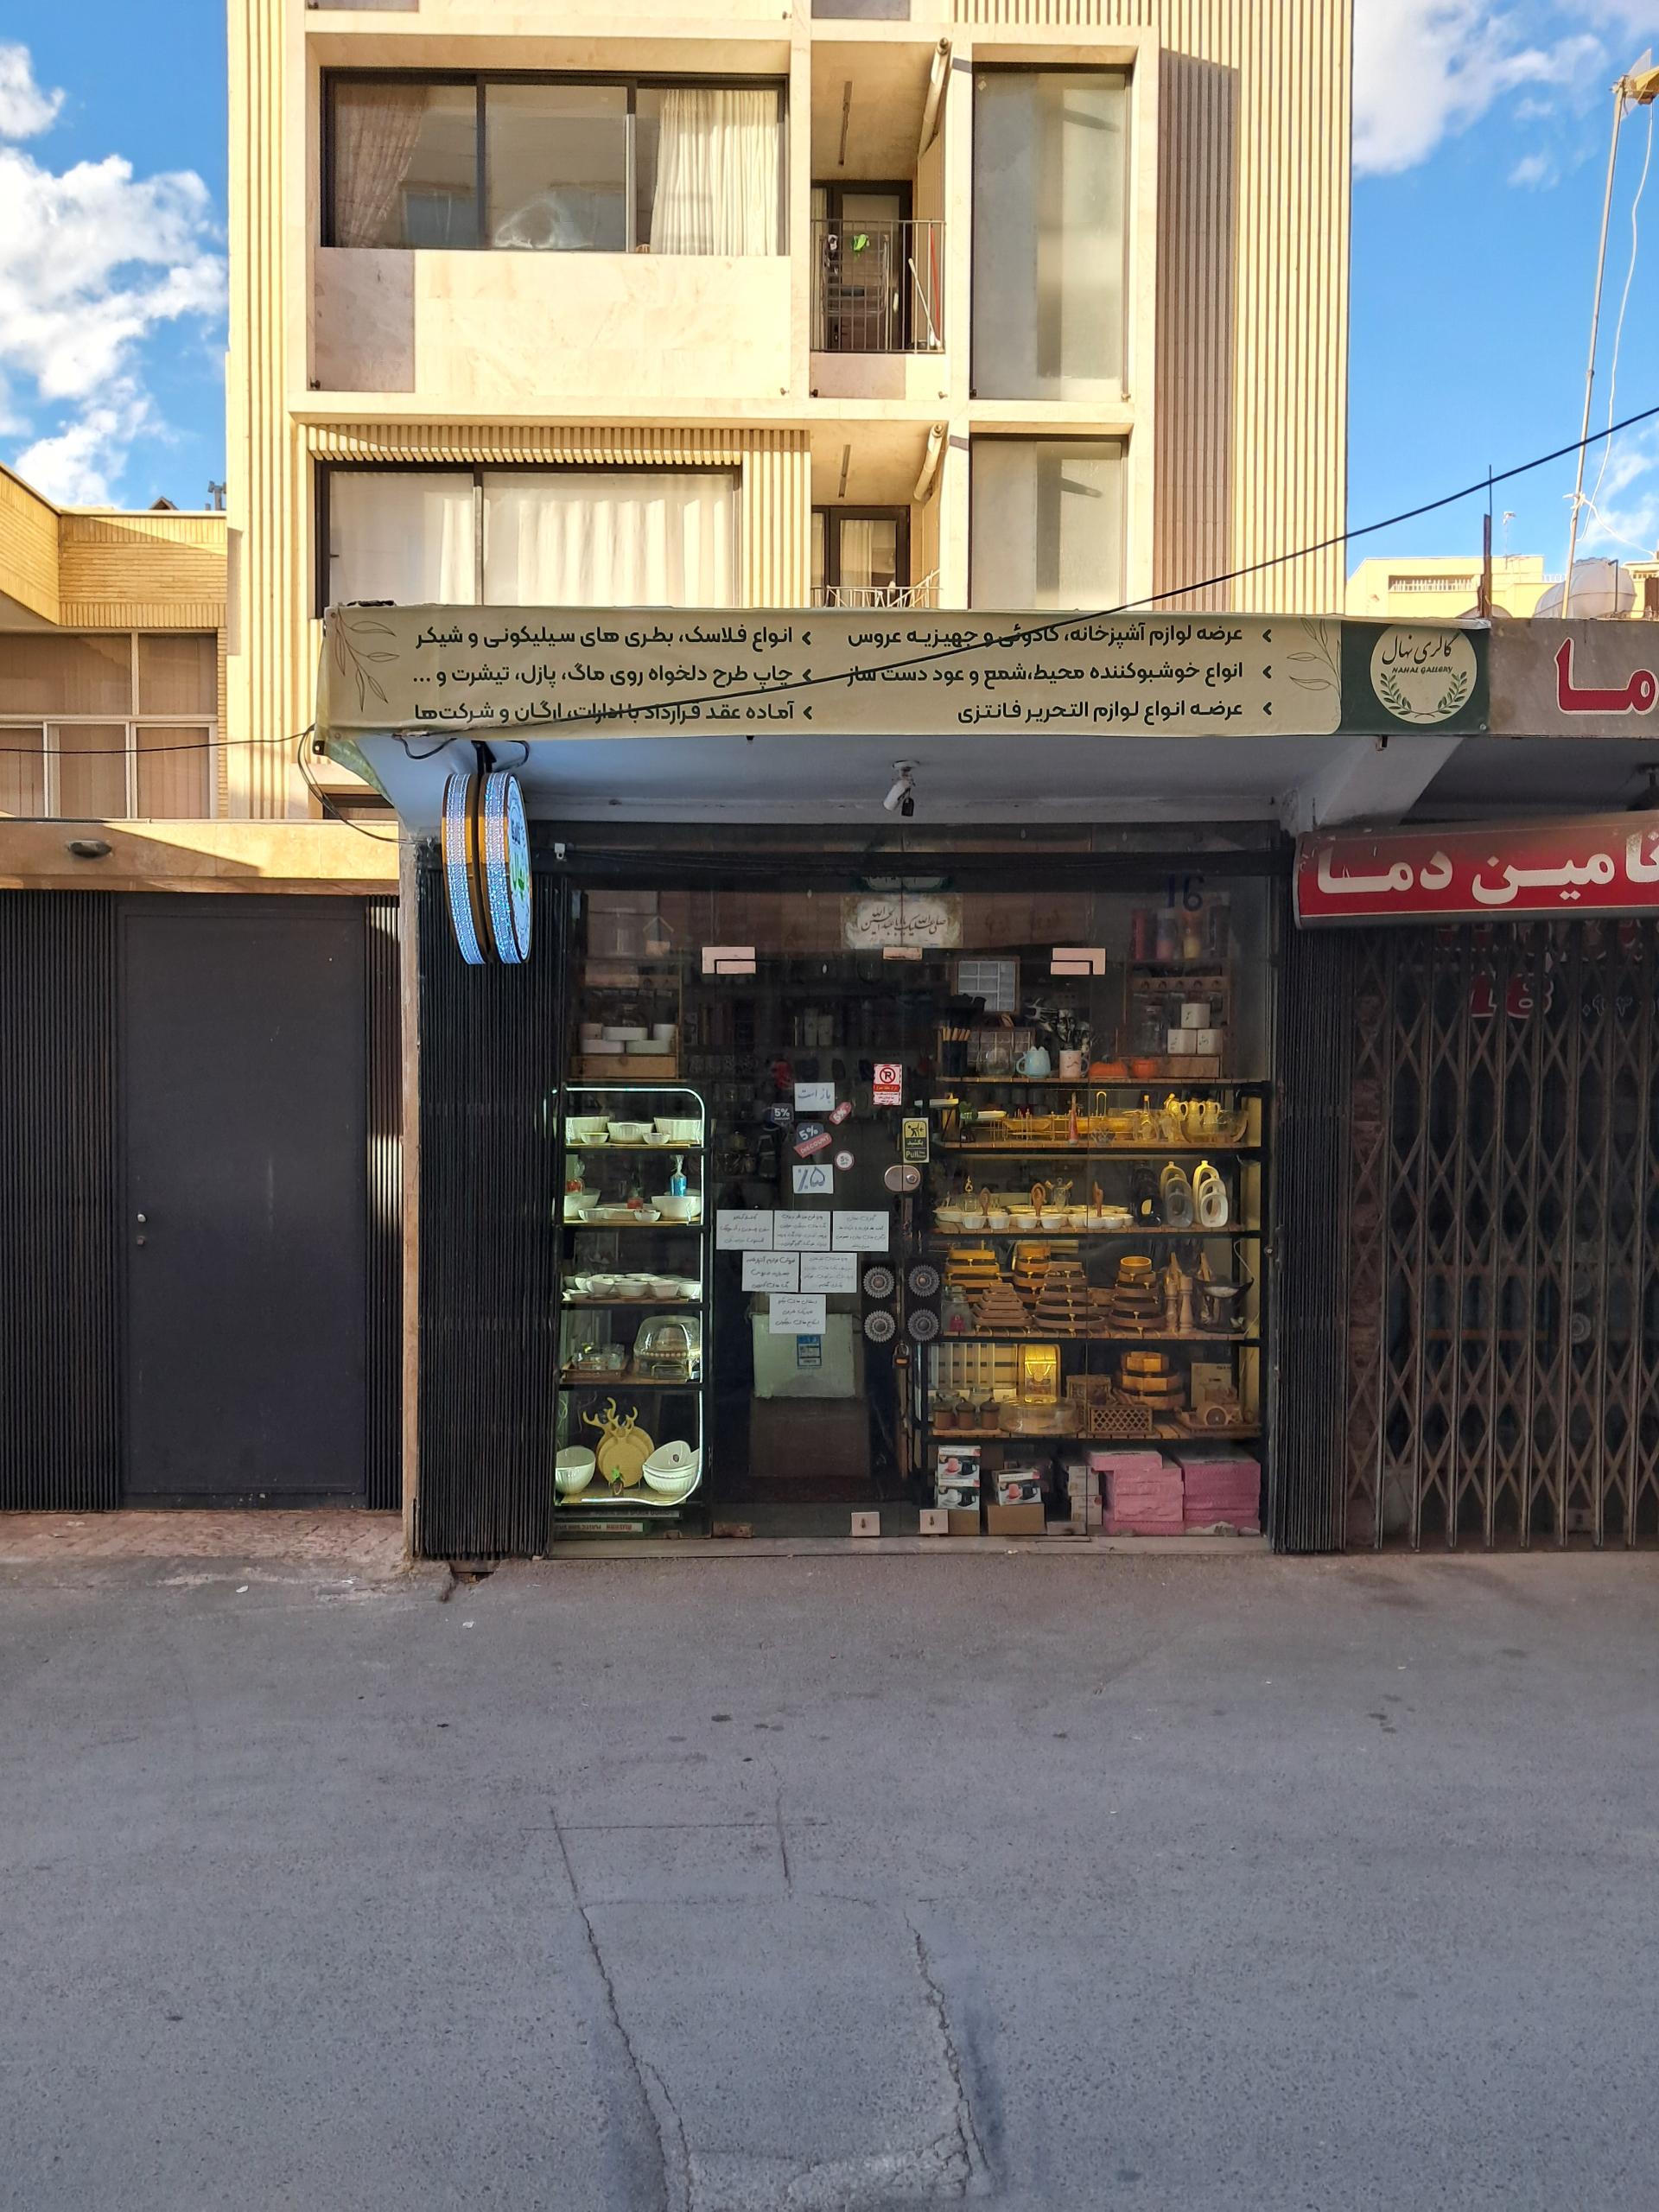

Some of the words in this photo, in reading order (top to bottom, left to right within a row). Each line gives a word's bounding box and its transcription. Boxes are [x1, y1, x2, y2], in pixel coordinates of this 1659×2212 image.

[416, 625, 463, 649] شیکر
[467, 632, 478, 648] و
[484, 626, 575, 648] سیلیکونی
[580, 626, 620, 647] های
[625, 626, 673, 647] بطری
[753, 626, 792, 652] انواع
[848, 632, 901, 648] عروس
[906, 629, 978, 649] جهیزیه
[983, 632, 994, 647] و
[1149, 625, 1192, 646] لوازم
[1196, 626, 1243, 645] عرضه
[1382, 633, 1413, 664] نهال
[436, 671, 447, 688] و
[452, 664, 510, 687] تیشرت
[610, 671, 644, 686] روی
[648, 664, 708, 686] دلخواه
[712, 665, 748, 688] طرح
[753, 665, 792, 690] چاپ
[881, 669, 928, 681] دست
[932, 670, 964, 686] عود
[969, 670, 979, 686] و
[1090, 662, 1200, 684] خوشبوکننده
[1205, 662, 1243, 687] انواع
[499, 708, 510, 723] و
[515, 700, 562, 723] ارگان
[645, 701, 701, 725] قرارداد
[706, 704, 741, 720] عقد
[747, 701, 795, 719] آماده
[958, 700, 1022, 724] فانتزی
[1025, 702, 1088, 723] التحریر
[1093, 701, 1139, 722] لوازم
[1144, 700, 1185, 725] انواع
[1190, 701, 1243, 721] عرضه
[1317, 845, 1453, 894] دما
[798, 1089, 817, 1099] است
[821, 1088, 831, 1104] باز
[774, 1107, 791, 1118] 5%
[798, 1125, 819, 1141] 5%
[800, 1136, 830, 1155] DISCOUNT
